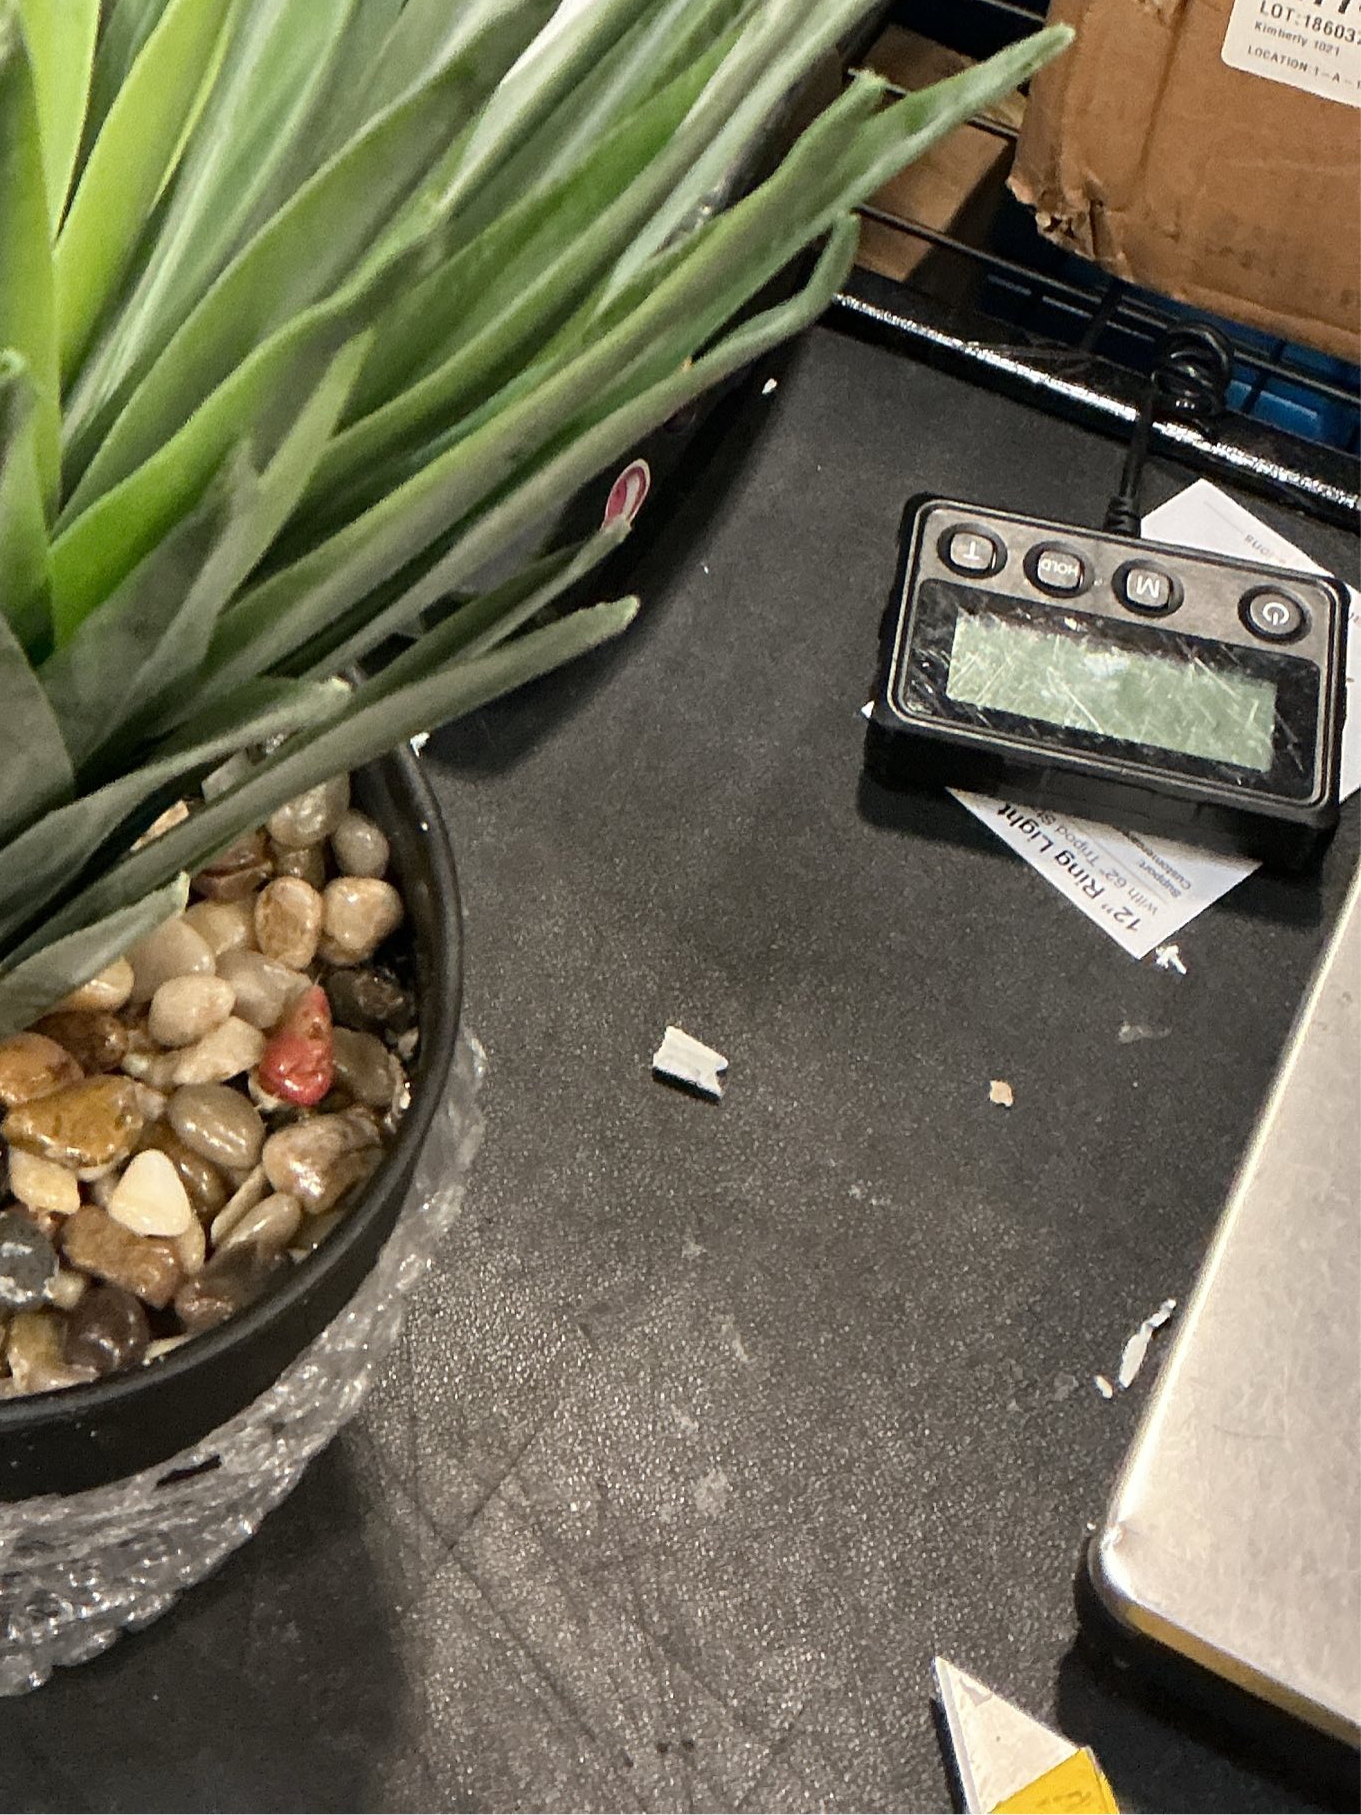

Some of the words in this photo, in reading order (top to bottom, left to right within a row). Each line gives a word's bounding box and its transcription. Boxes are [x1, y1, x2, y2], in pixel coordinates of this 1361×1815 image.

[1254, 20, 1309, 48] Kimberly
[1314, 40, 1341, 57] 1021
[962, 541, 980, 561] T
[1040, 558, 1079, 578] HOLD
[1135, 575, 1160, 599] M
[996, 802, 1055, 854] Light
[1054, 825, 1100, 867] Tripod
[1054, 850, 1106, 900] Ring
[1128, 886, 1158, 916] with
